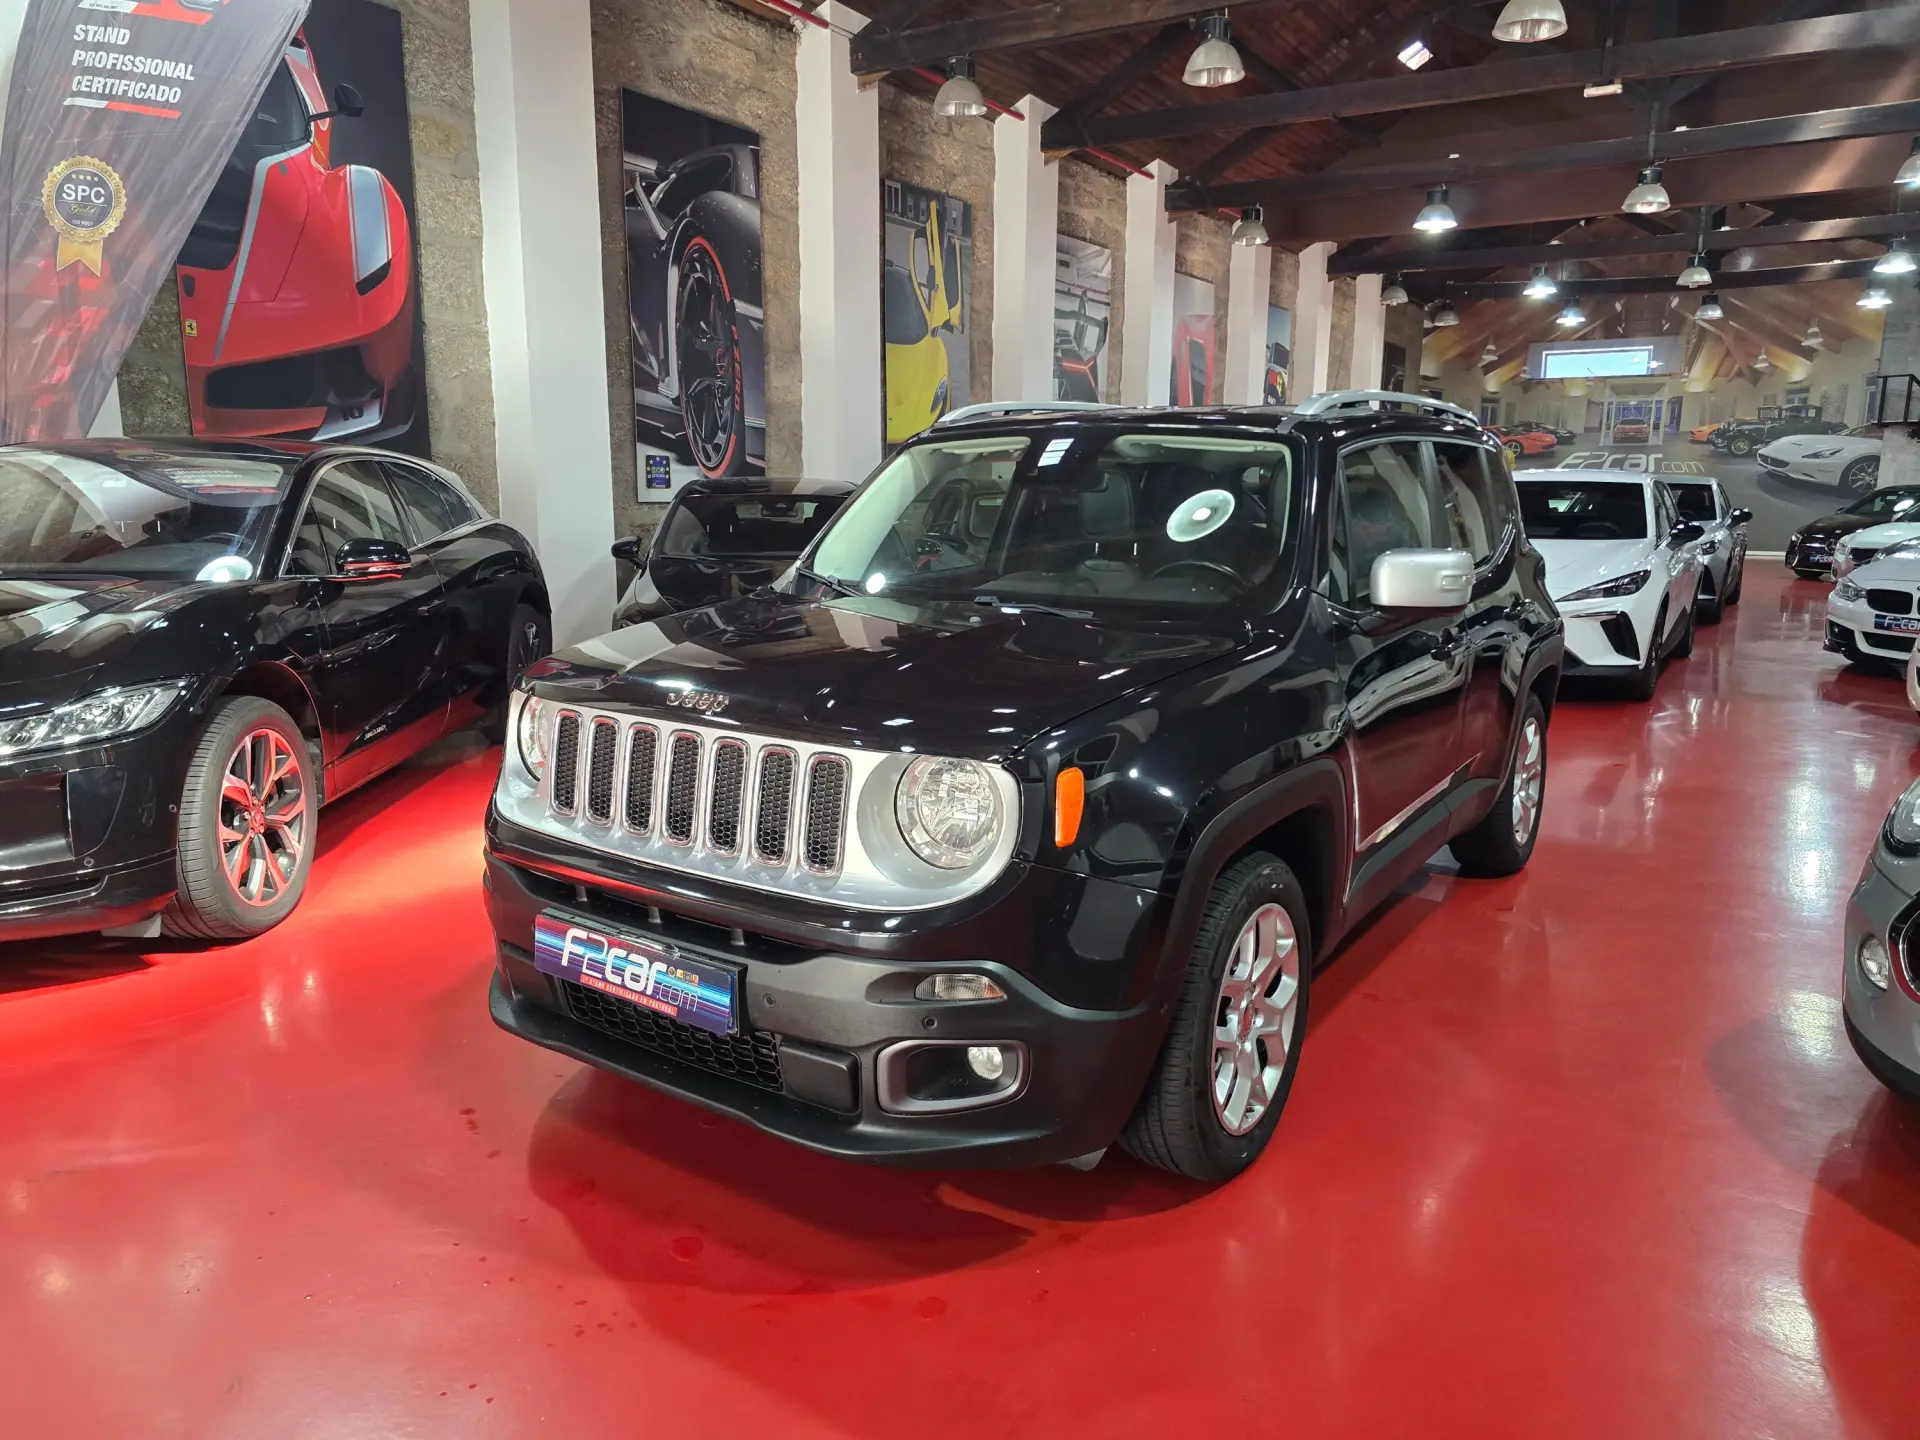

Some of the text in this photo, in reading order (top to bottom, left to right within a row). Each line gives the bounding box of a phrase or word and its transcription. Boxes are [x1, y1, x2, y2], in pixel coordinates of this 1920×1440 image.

[73, 24, 131, 45] STAND
[71, 49, 195, 81] PROFISSIONAL
[71, 75, 182, 103] CERTIFICADO
[62, 183, 106, 204] SPC
[69, 203, 97, 214] Gold
[666, 691, 730, 716] Jeep
[363, 724, 388, 741] JAGUAR
